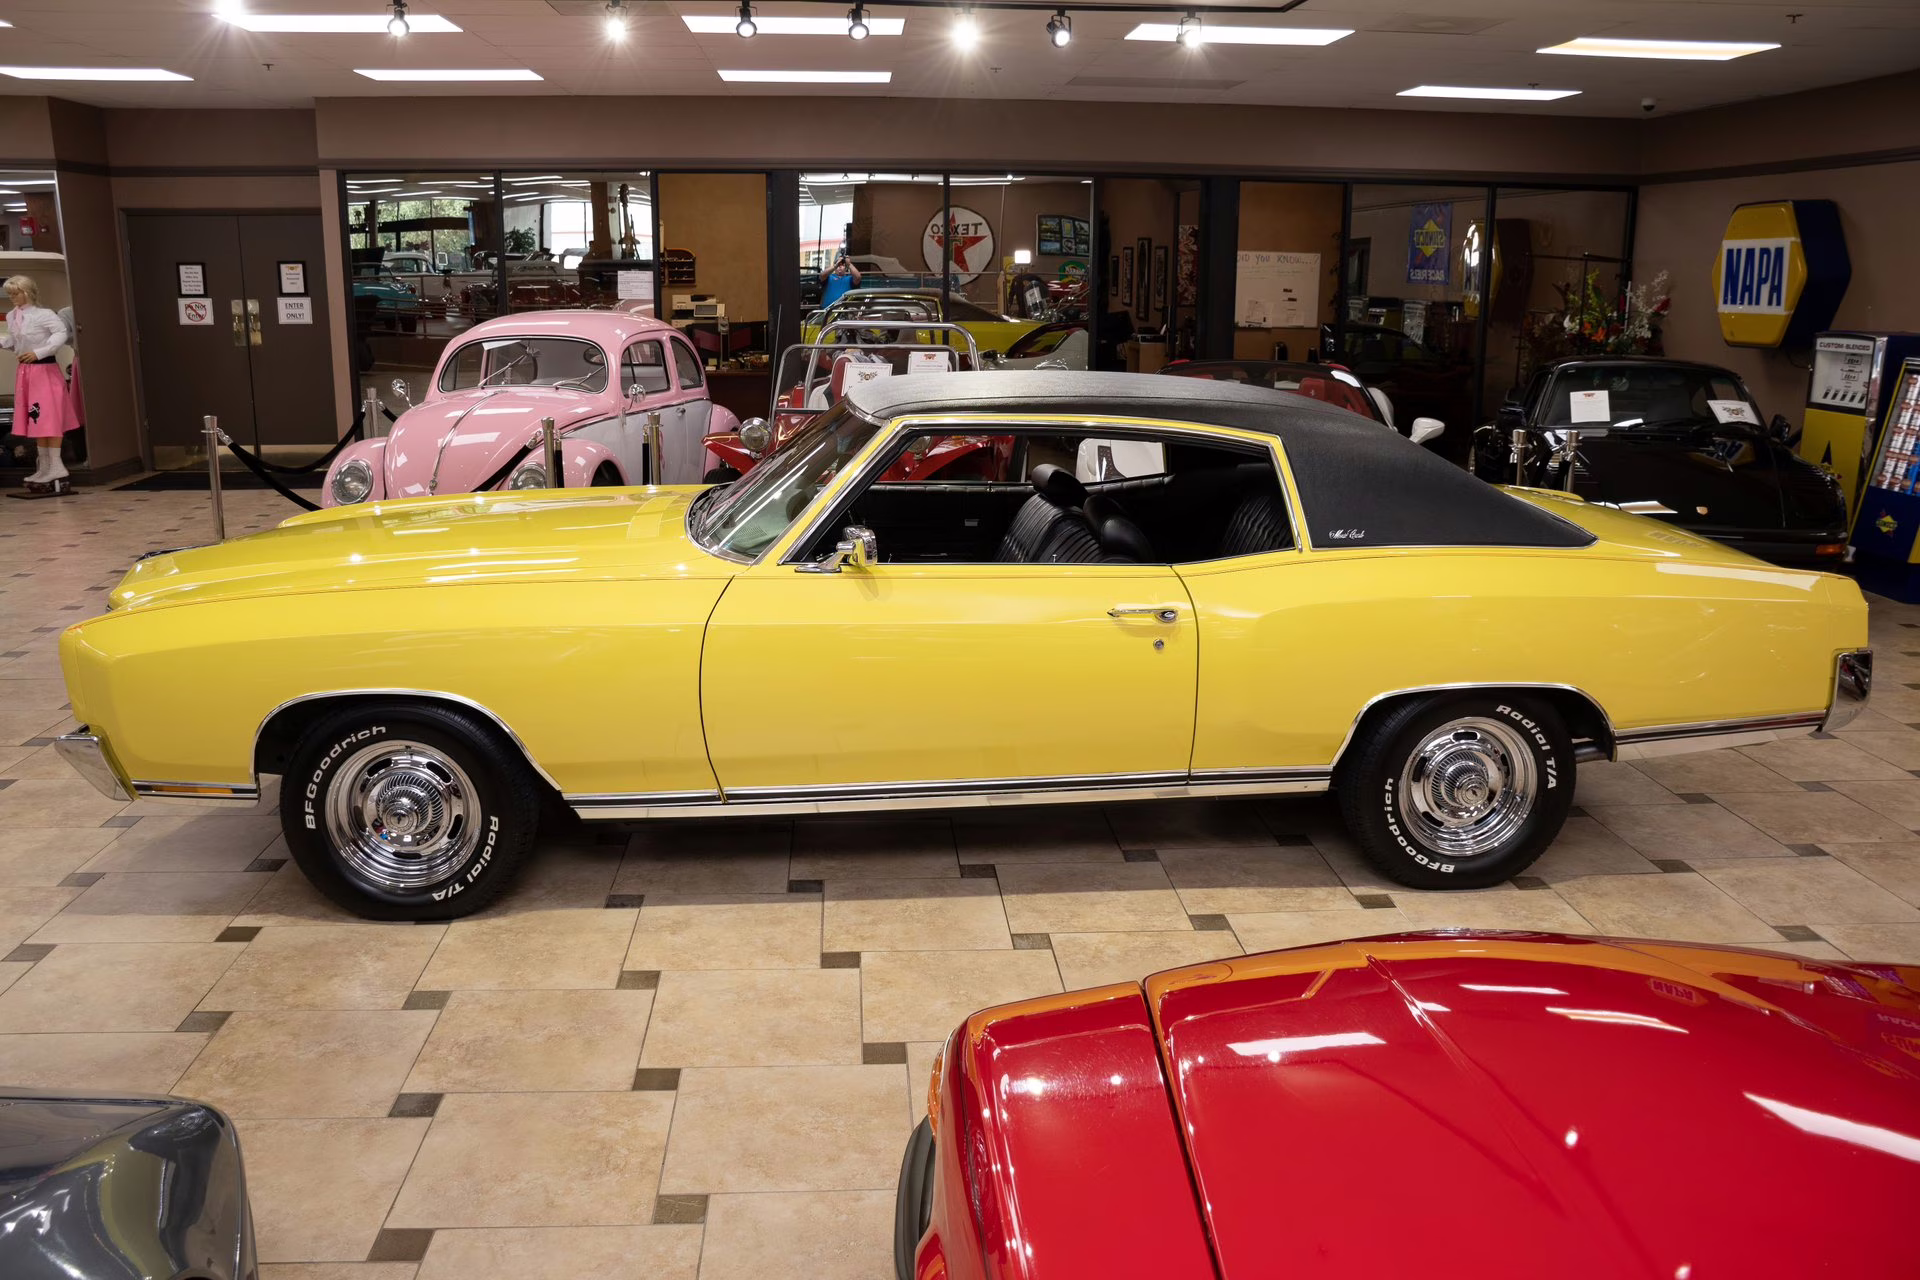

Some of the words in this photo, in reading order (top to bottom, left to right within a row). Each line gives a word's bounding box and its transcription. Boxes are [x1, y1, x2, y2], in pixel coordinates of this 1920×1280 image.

[1722, 246, 1785, 307] NAPA
[305, 725, 387, 829] BFGoodrich
[1495, 704, 1550, 751] Radial
[1545, 757, 1557, 789] T/A
[467, 815, 499, 883] Radial
[1384, 777, 1456, 873] BFGoodrich
[431, 883, 465, 902] T/A
